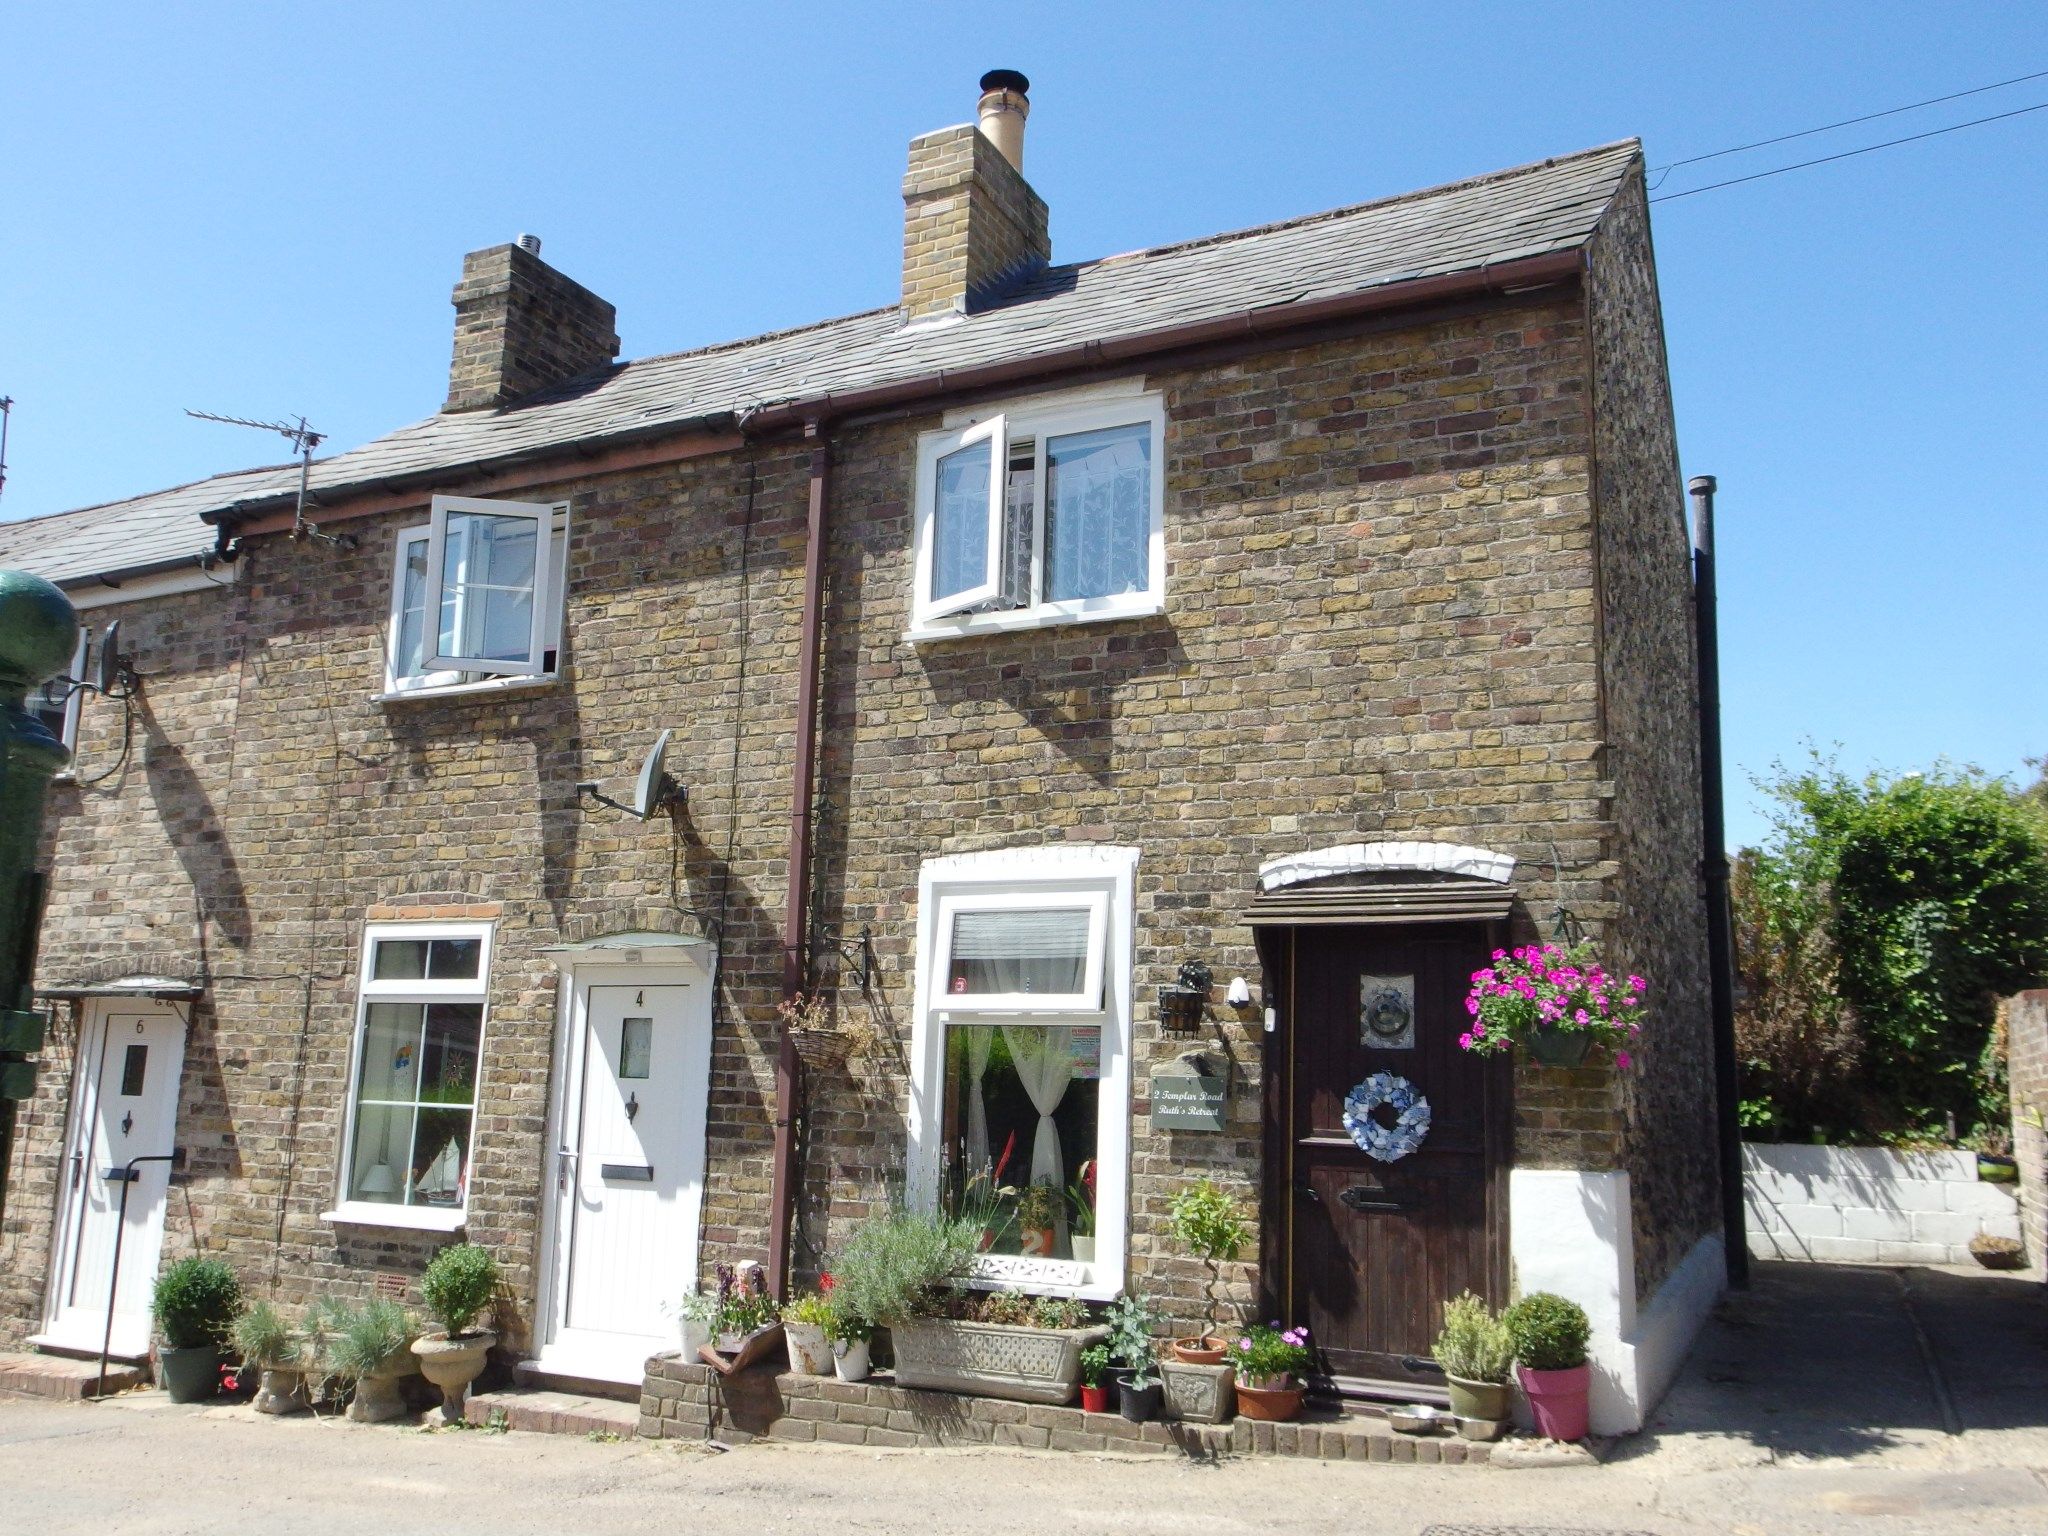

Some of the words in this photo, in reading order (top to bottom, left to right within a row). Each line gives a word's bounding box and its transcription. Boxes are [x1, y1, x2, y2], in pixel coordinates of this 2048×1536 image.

[635, 990, 644, 1007] 4
[136, 1019, 144, 1034] 6
[1153, 1089, 1160, 1100] 2
[1161, 1090, 1197, 1102] Templar
[1199, 1091, 1224, 1101] Road
[1158, 1104, 1186, 1115] Ruth's
[1187, 1105, 1219, 1116] Retreat
[1020, 1230, 1044, 1257] 2
